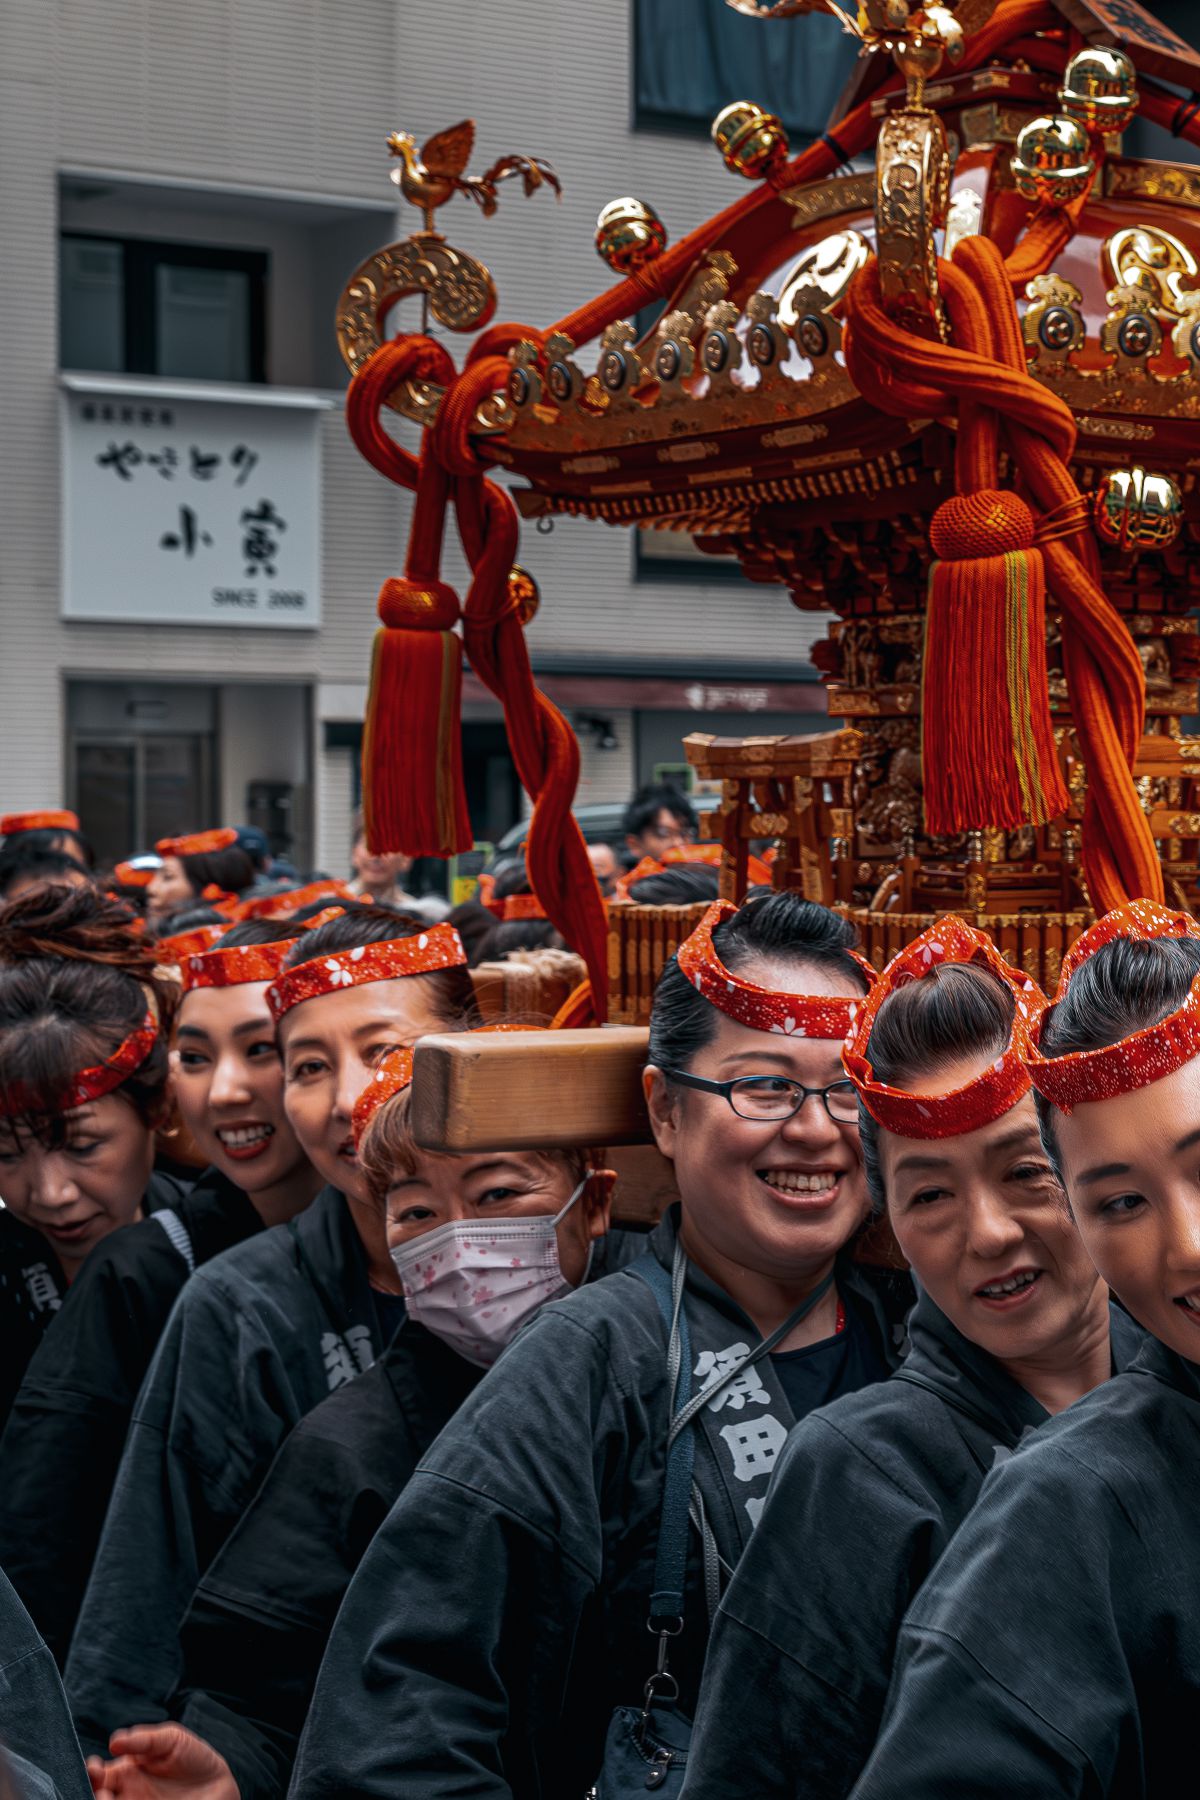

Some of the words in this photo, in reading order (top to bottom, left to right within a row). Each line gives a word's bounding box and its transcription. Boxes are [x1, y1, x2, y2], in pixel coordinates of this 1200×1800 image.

[95, 440, 260, 487] やきとり
[212, 587, 257, 608] SINCE
[693, 1342, 788, 1529] 須田
